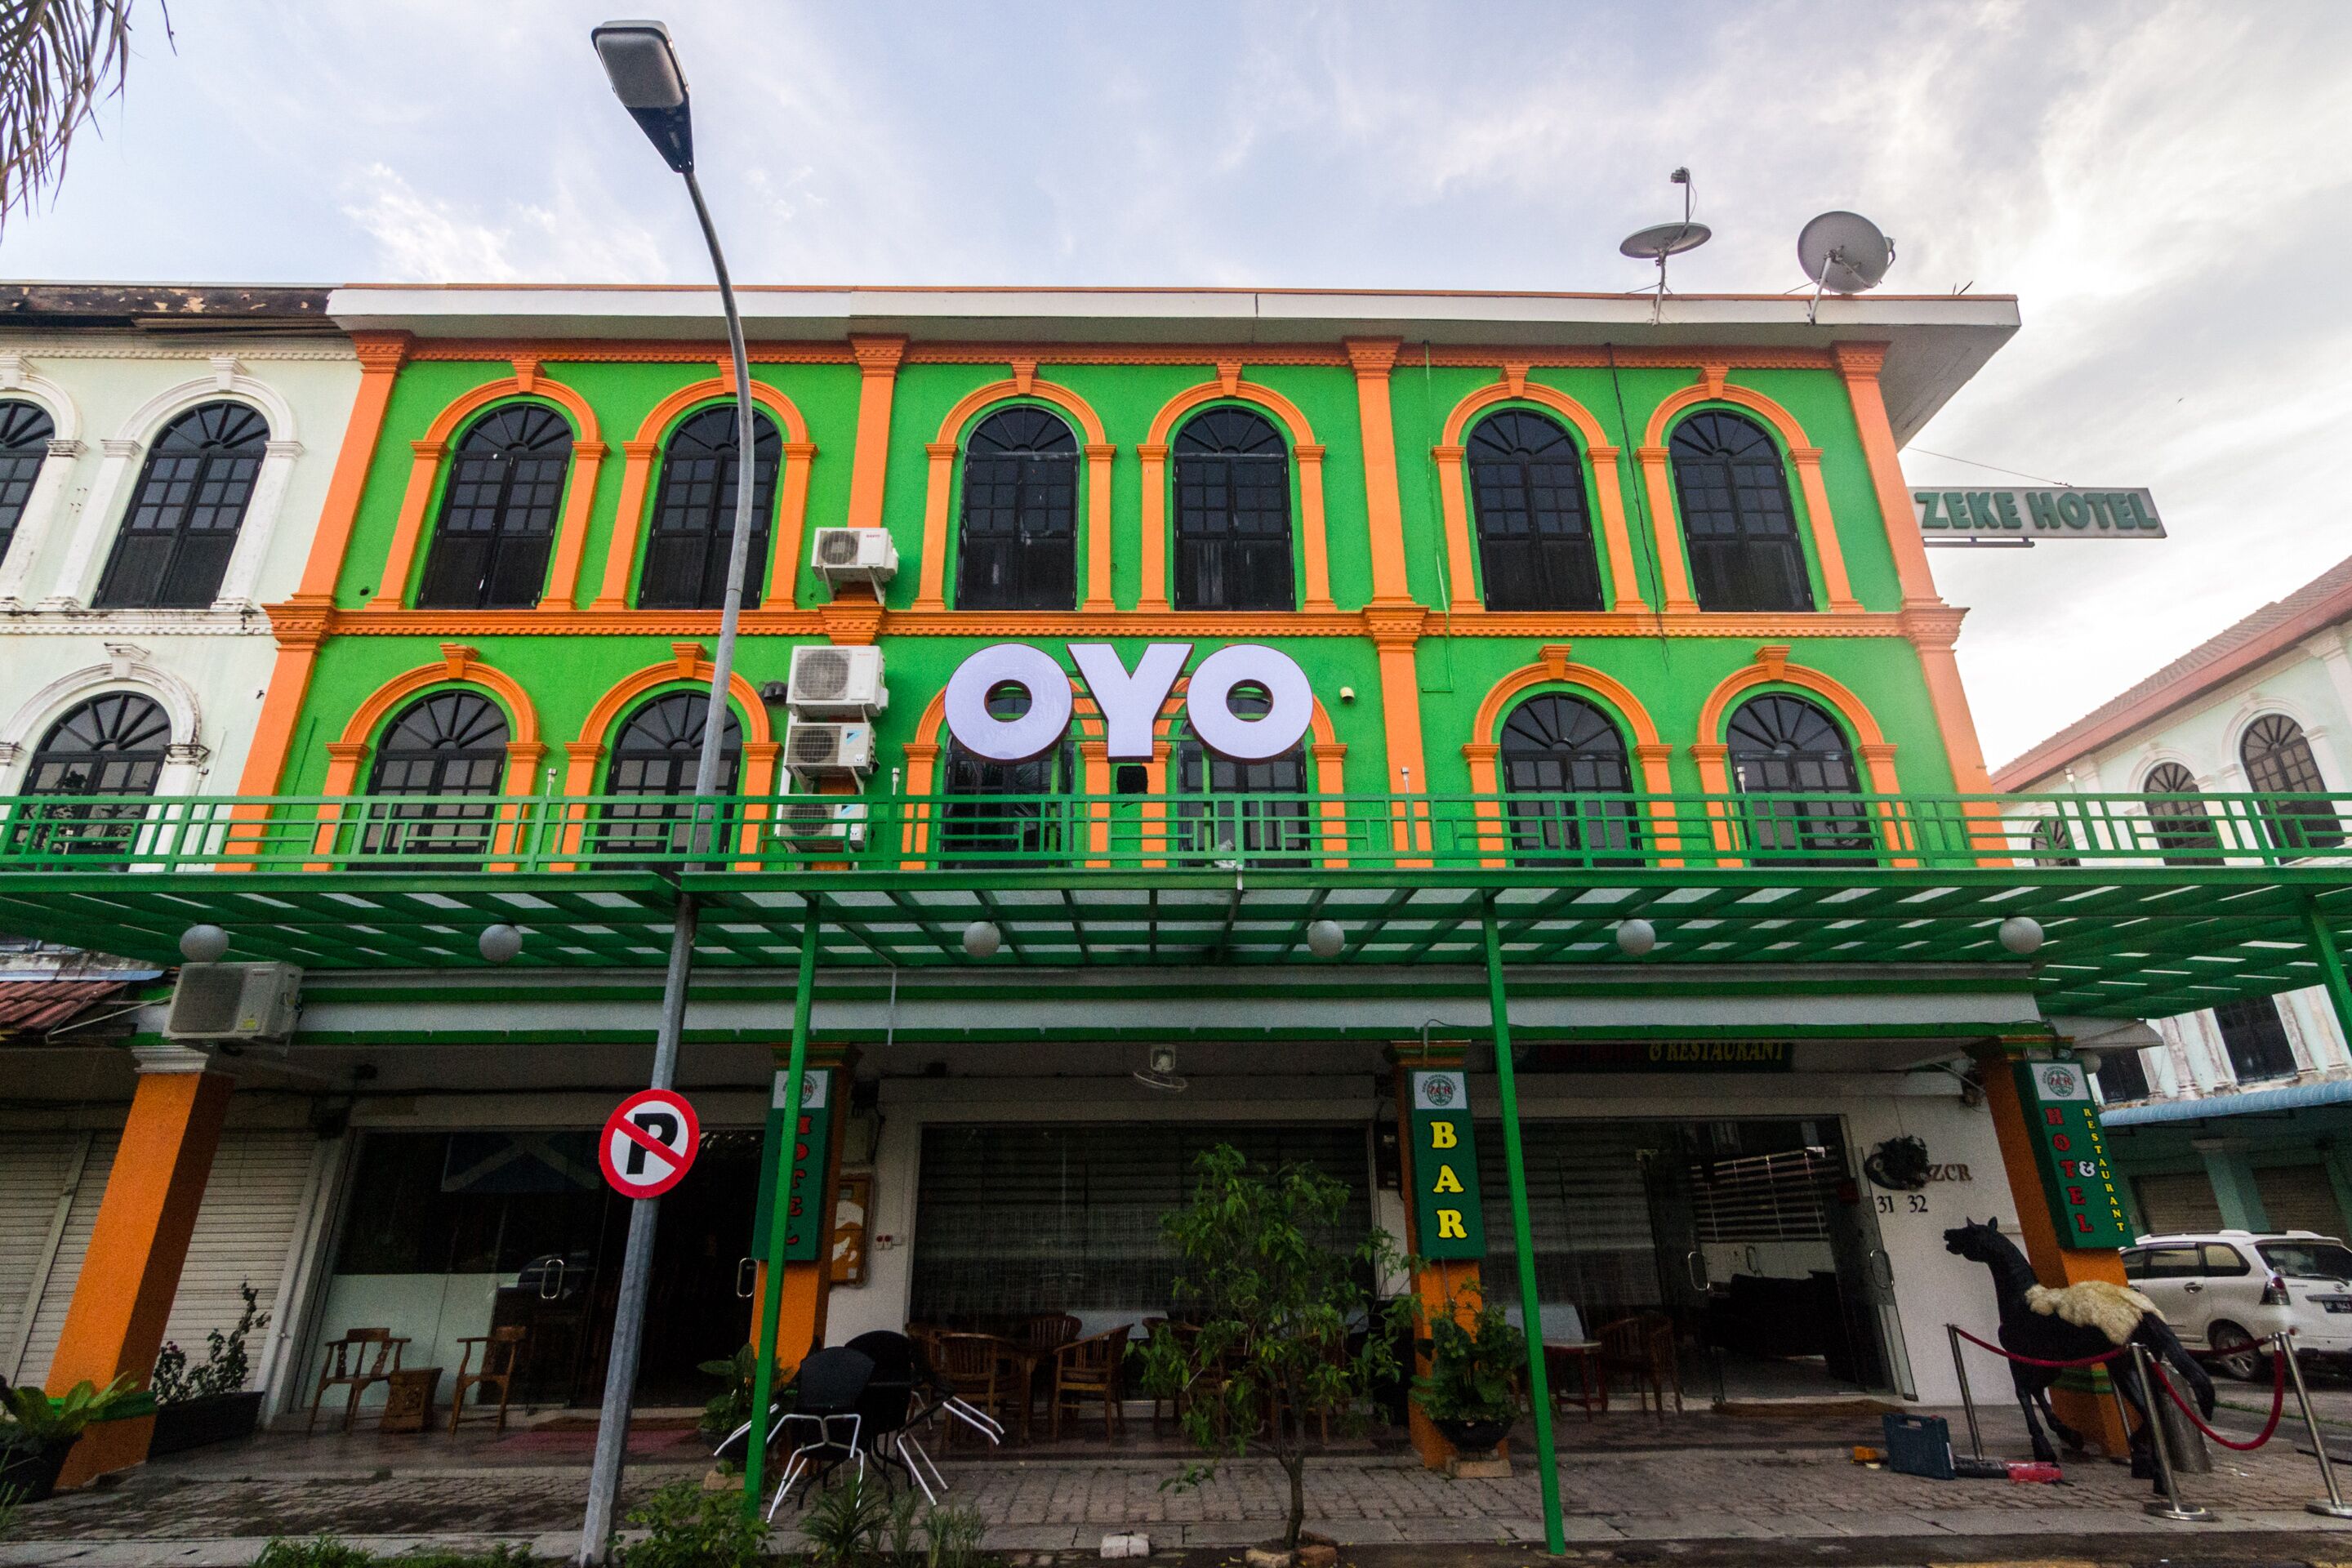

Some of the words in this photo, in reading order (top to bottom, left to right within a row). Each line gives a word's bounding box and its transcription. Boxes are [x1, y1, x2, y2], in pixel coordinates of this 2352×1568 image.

[1914, 492, 2022, 529] ZEKE
[2025, 492, 2158, 529] HOTEL
[944, 643, 1313, 764] OYO
[1668, 1041, 1785, 1062] RESTAURANT
[626, 1113, 678, 1174] P
[1430, 1121, 1468, 1238] BAR
[1930, 1164, 1973, 1182] ZCR
[2045, 1107, 2093, 1232] HOTEL
[2078, 1161, 2096, 1178] &
[2082, 1108, 2124, 1232] RESTAURANT
[1877, 1196, 1895, 1213] 31
[1908, 1195, 1928, 1213] 32
